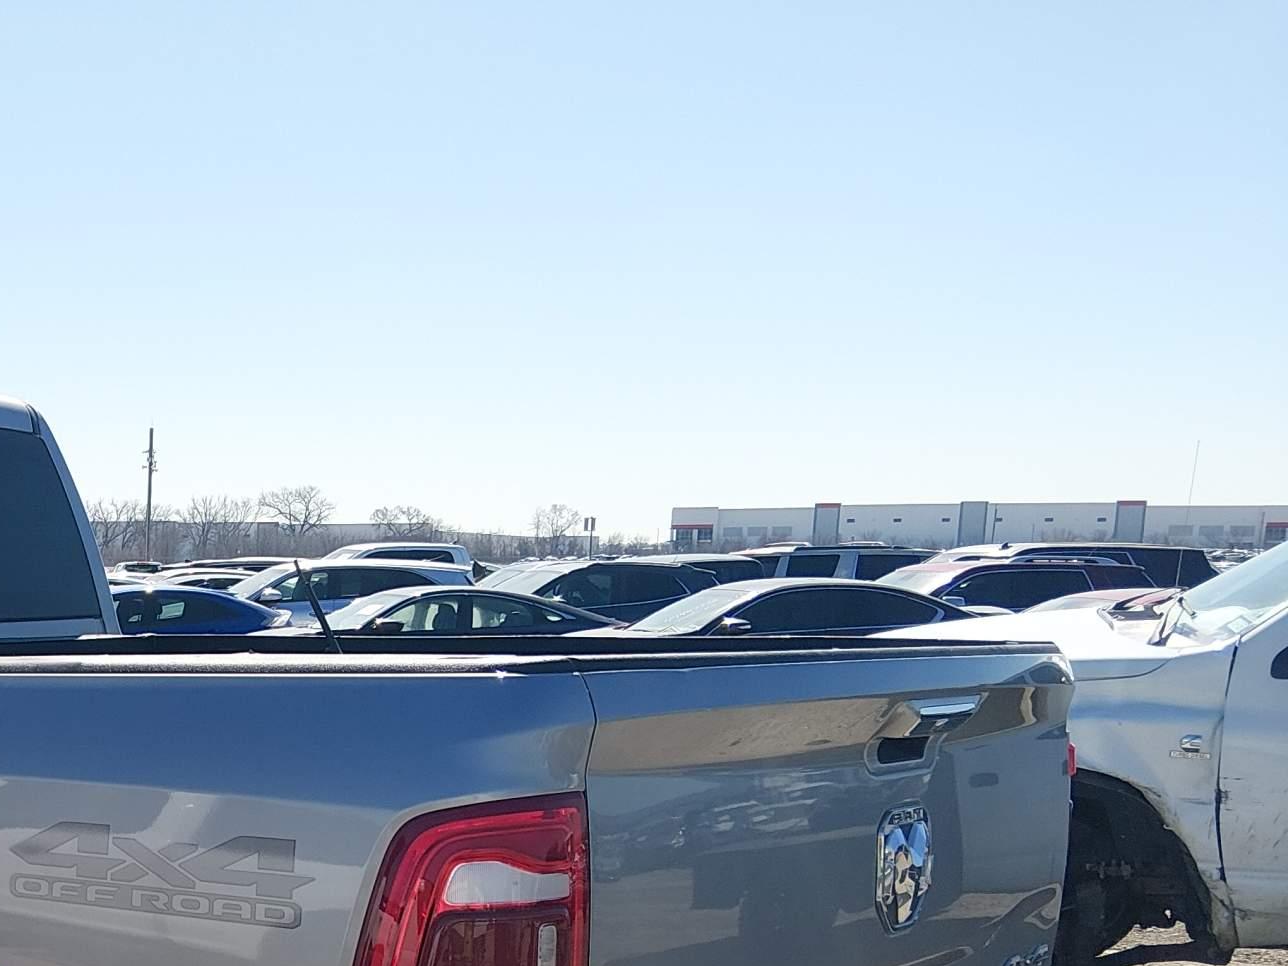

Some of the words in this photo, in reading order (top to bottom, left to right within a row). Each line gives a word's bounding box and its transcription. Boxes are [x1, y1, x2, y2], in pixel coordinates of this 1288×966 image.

[892, 808, 924, 824] RAM
[14, 876, 120, 902] OFF
[130, 888, 297, 925] ROAD
